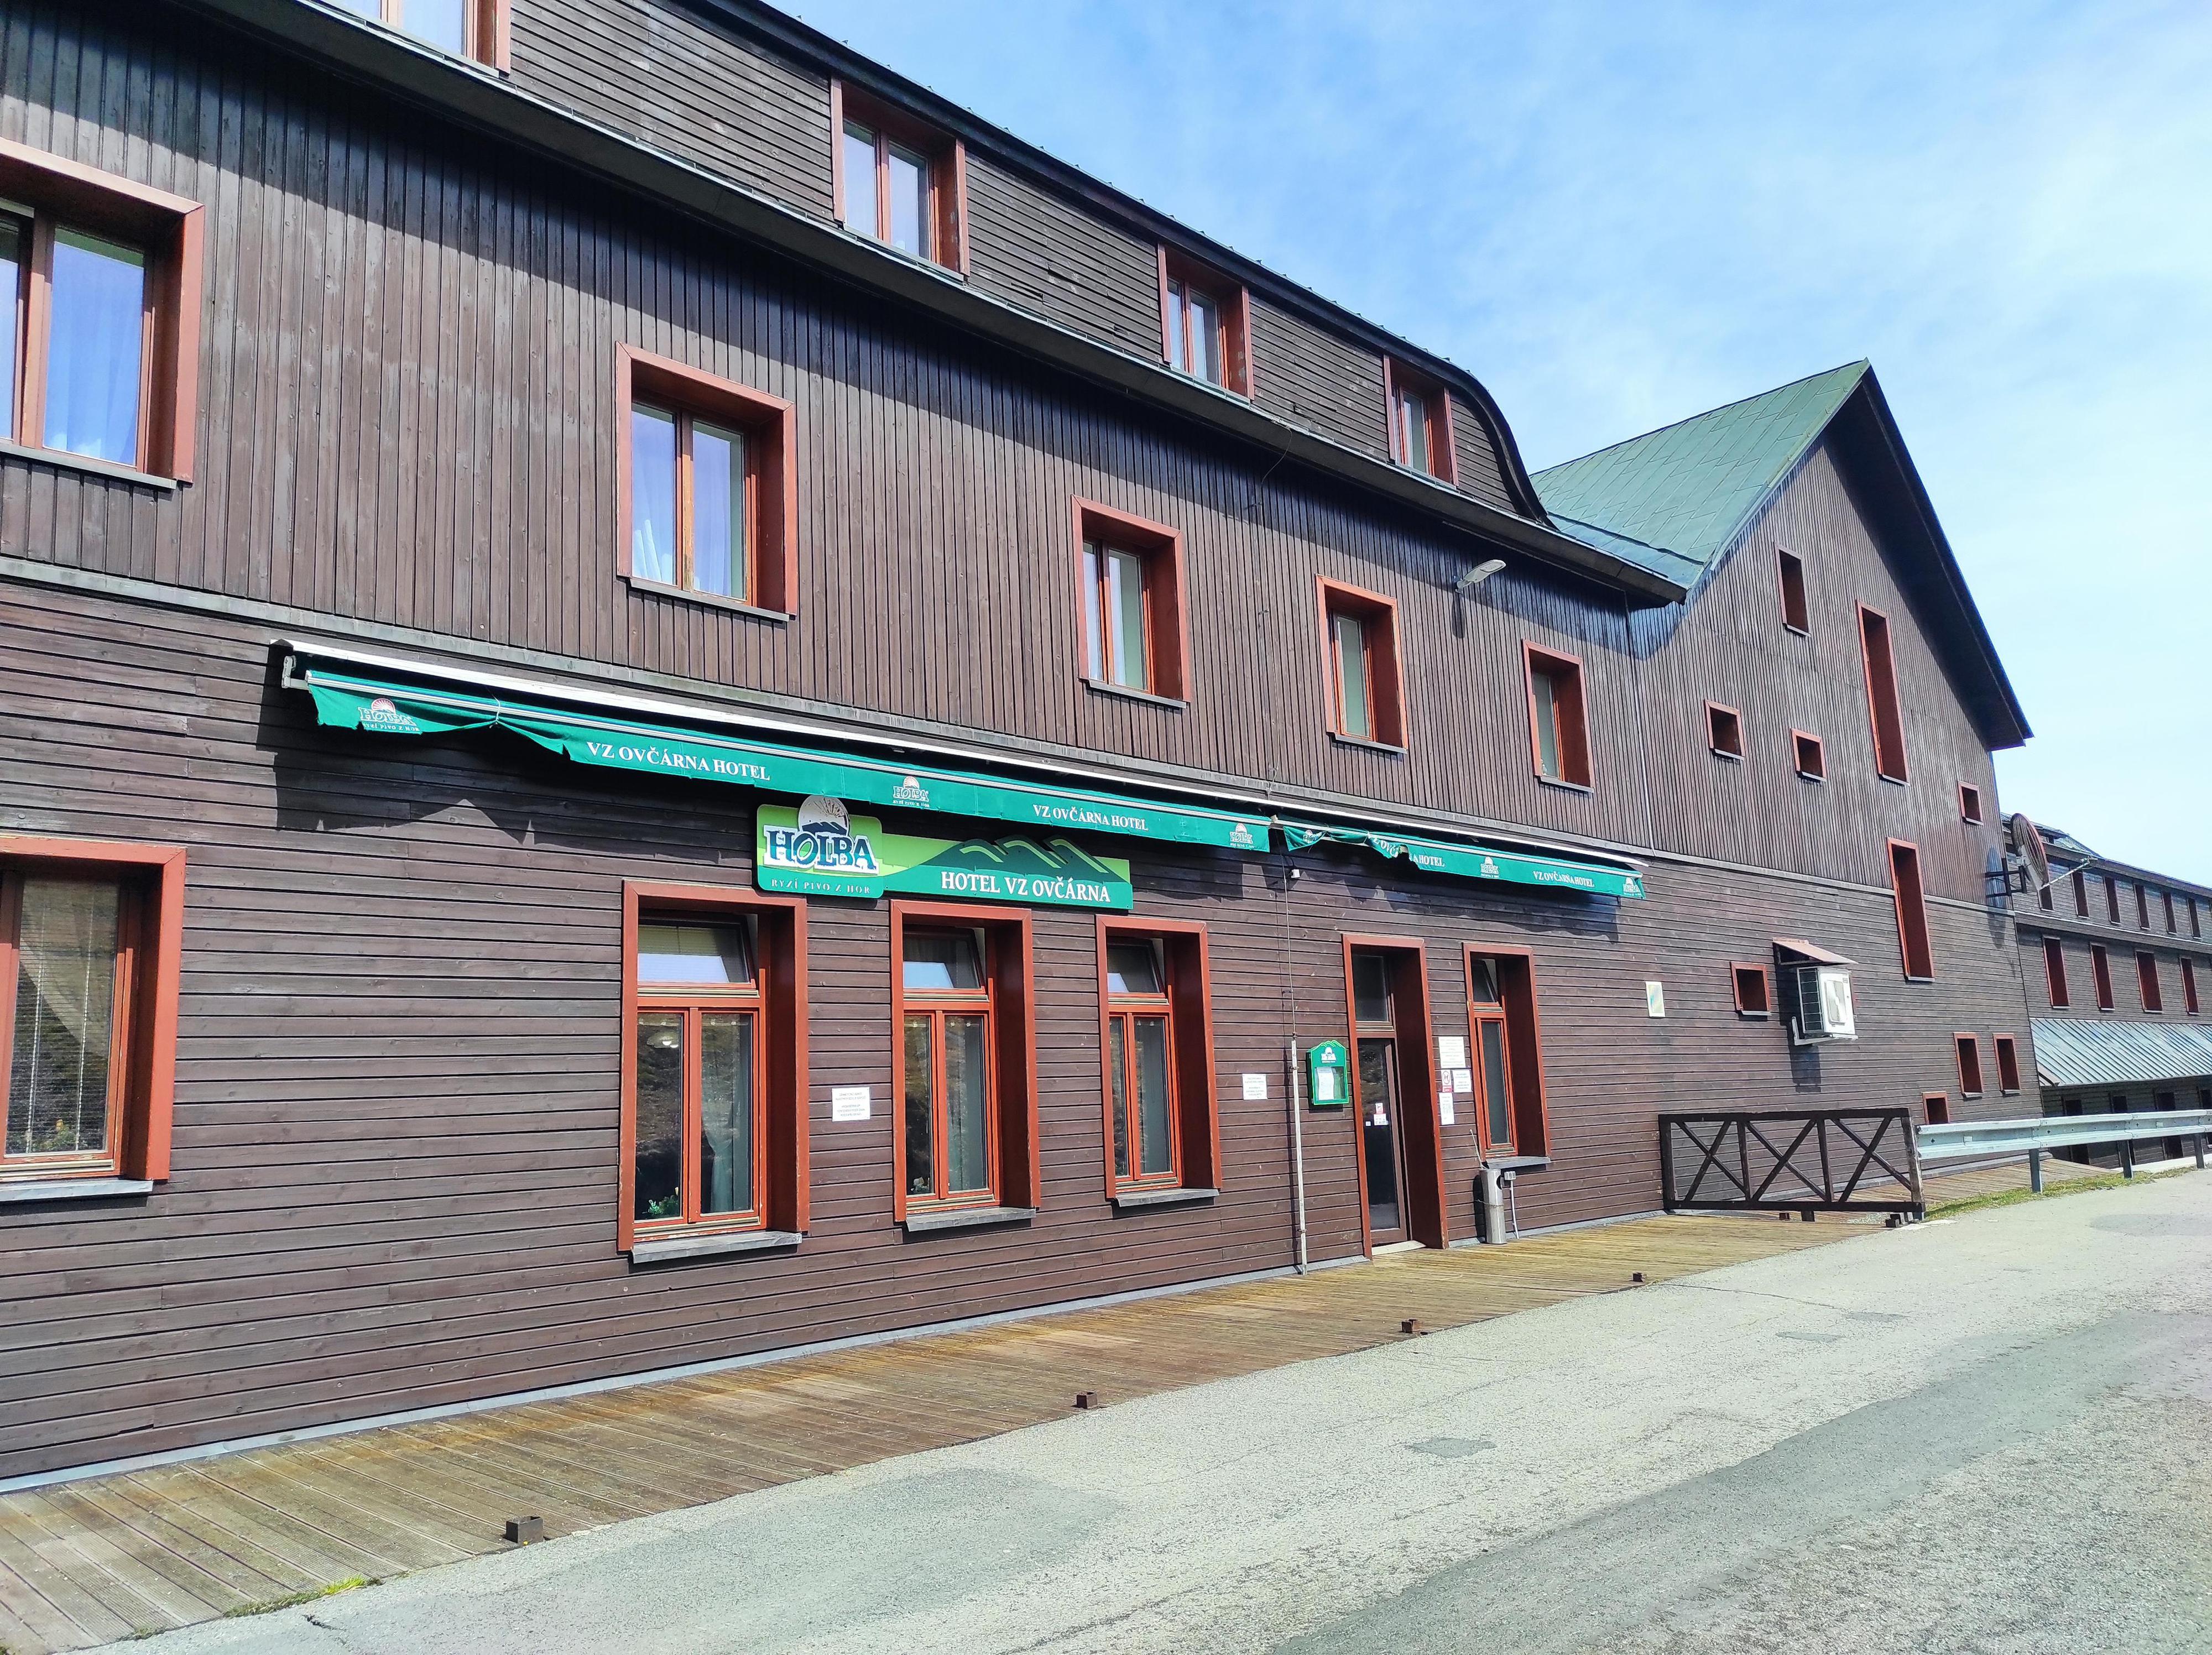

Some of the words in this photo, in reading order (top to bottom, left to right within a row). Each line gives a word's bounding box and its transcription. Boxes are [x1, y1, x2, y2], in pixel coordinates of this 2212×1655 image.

[587, 742, 615, 759] VZ
[619, 745, 710, 771] OVČÁRNA
[712, 759, 770, 781] HOTEL
[893, 786, 929, 802] HOLBA
[1033, 805, 1050, 817] VZ
[1052, 806, 1110, 826] OVČÁRNA
[1110, 815, 1149, 831] HOTEL
[765, 829, 877, 871] HOLBA
[1419, 854, 1445, 867] HOTEL
[804, 881, 830, 891] PIVO
[847, 885, 870, 894] HOR
[941, 871, 1000, 893] HOTEL
[1004, 876, 1028, 895] VZ
[1032, 876, 1110, 902] OVČÁRNA
[1533, 871, 1543, 880] VZ
[1543, 870, 1574, 884] OVČÁRNA
[1574, 876, 1594, 887] HOTEL
